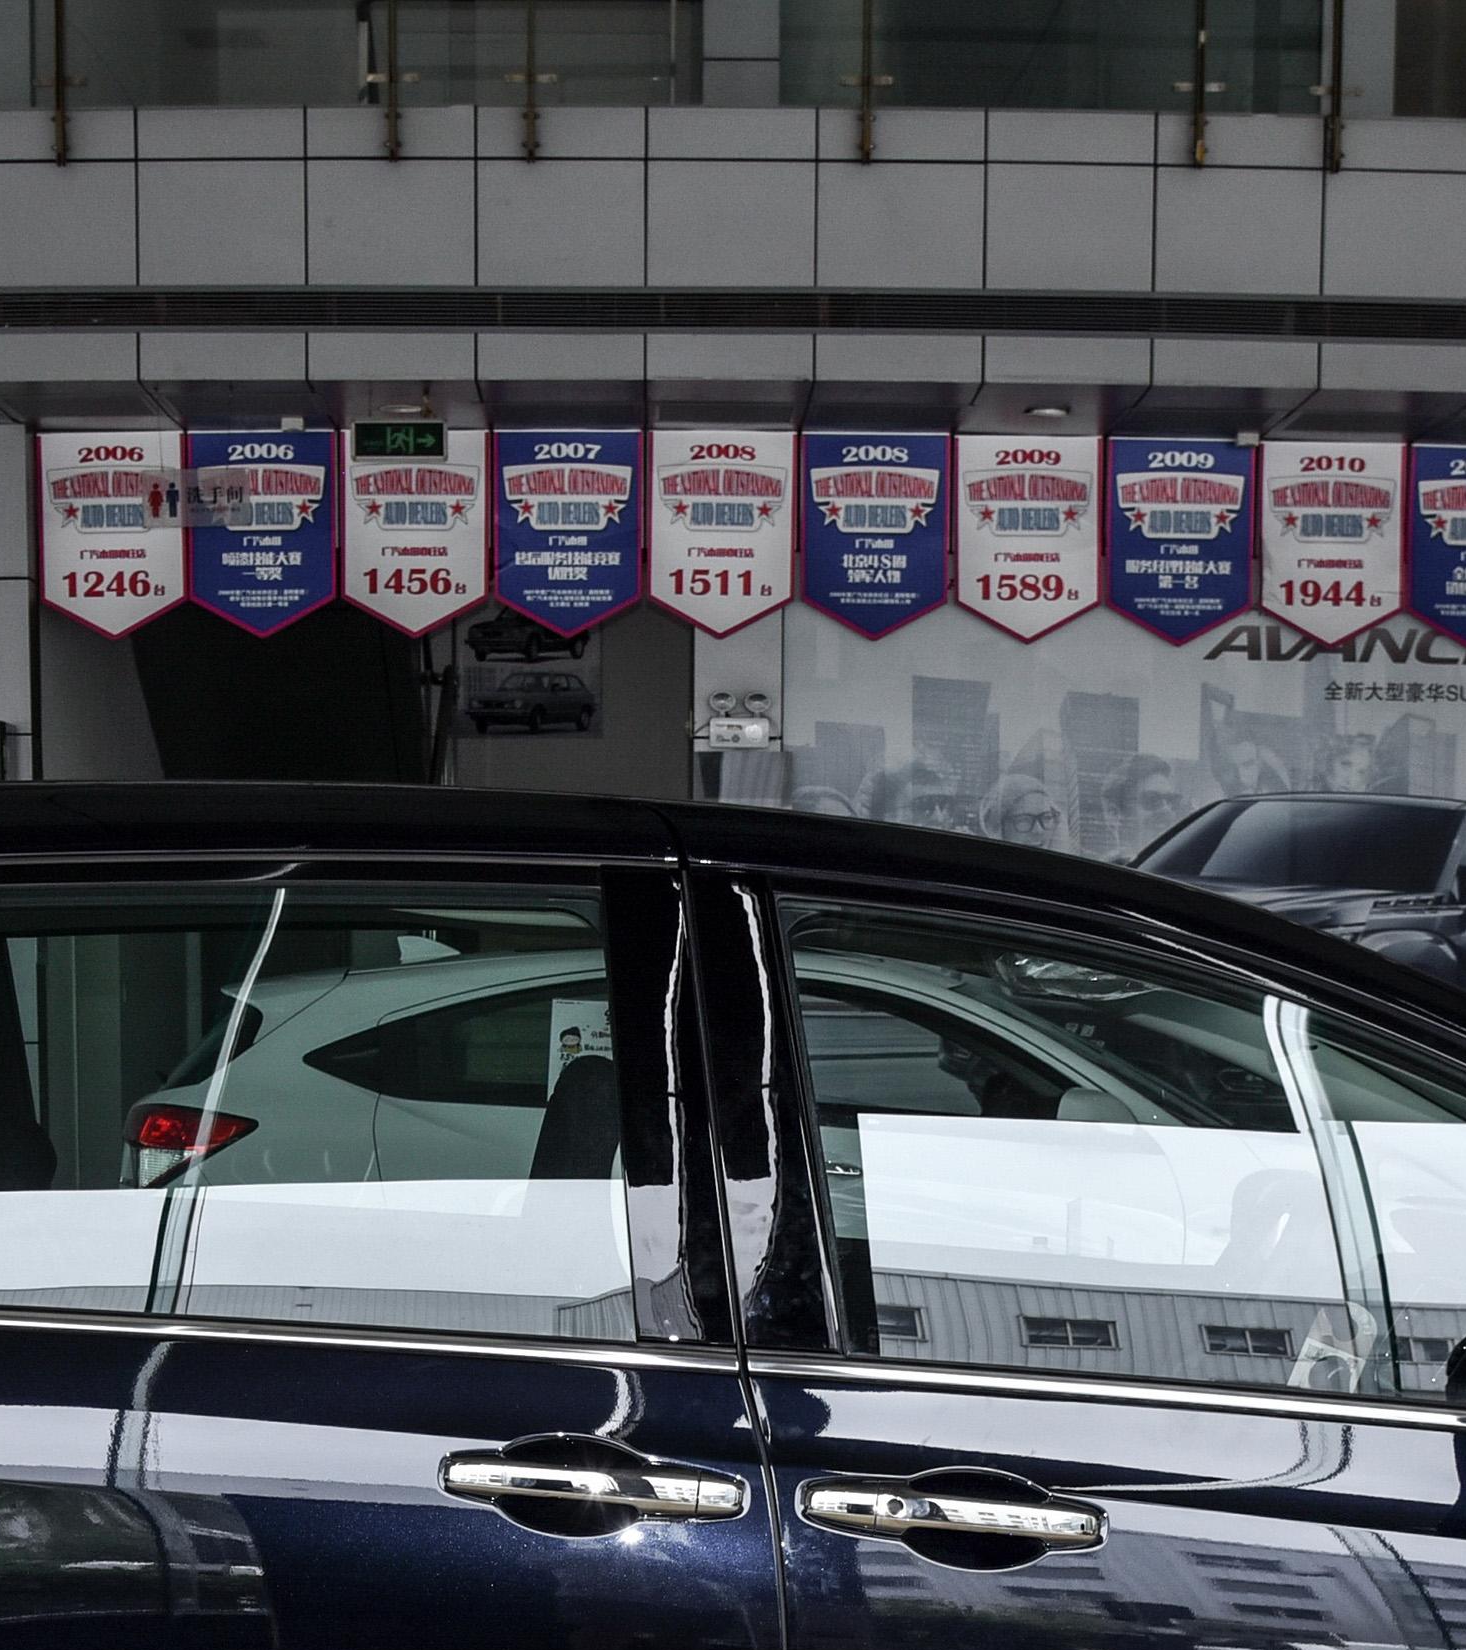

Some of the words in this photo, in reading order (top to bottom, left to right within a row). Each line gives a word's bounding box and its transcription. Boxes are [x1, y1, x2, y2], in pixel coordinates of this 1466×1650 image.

[78, 446, 144, 463] 2006
[228, 443, 294, 460] 2006
[534, 443, 602, 460] 2007
[690, 444, 756, 461] 2008
[842, 446, 908, 462] 2008
[995, 449, 1061, 466] 2009
[1148, 452, 1215, 469] 2009
[1300, 456, 1365, 473] 2010
